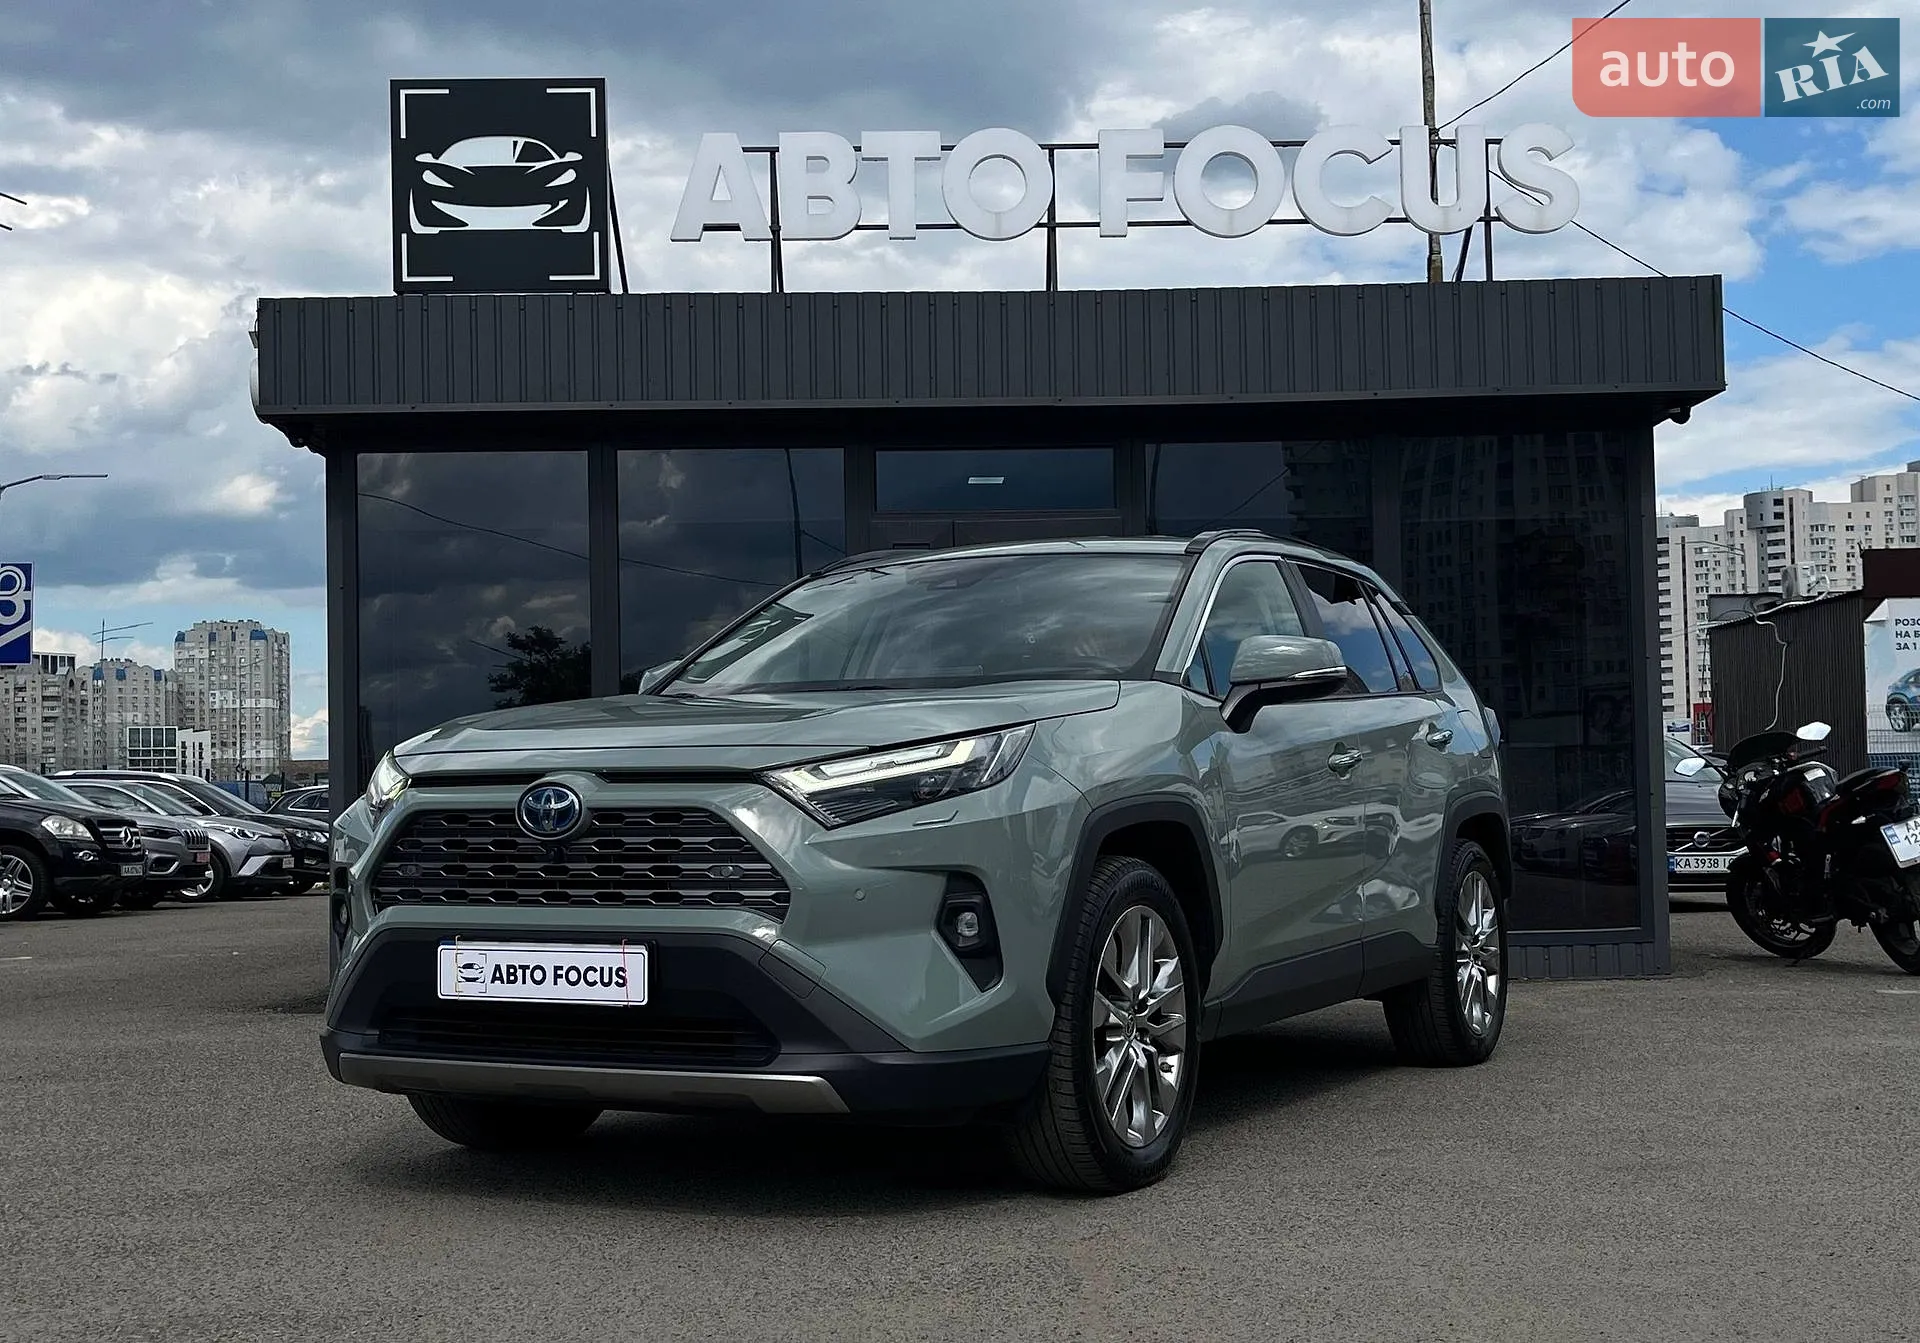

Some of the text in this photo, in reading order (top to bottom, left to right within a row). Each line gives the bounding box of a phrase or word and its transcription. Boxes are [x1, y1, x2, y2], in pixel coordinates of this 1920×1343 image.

[1097, 122, 1581, 238] FOCUS
[1895, 630, 1911, 639] НА
[1895, 642, 1910, 651] ЗА
[1675, 858, 1691, 869] KA
[1694, 858, 1719, 869] 3938
[553, 965, 627, 988] FOCUS
